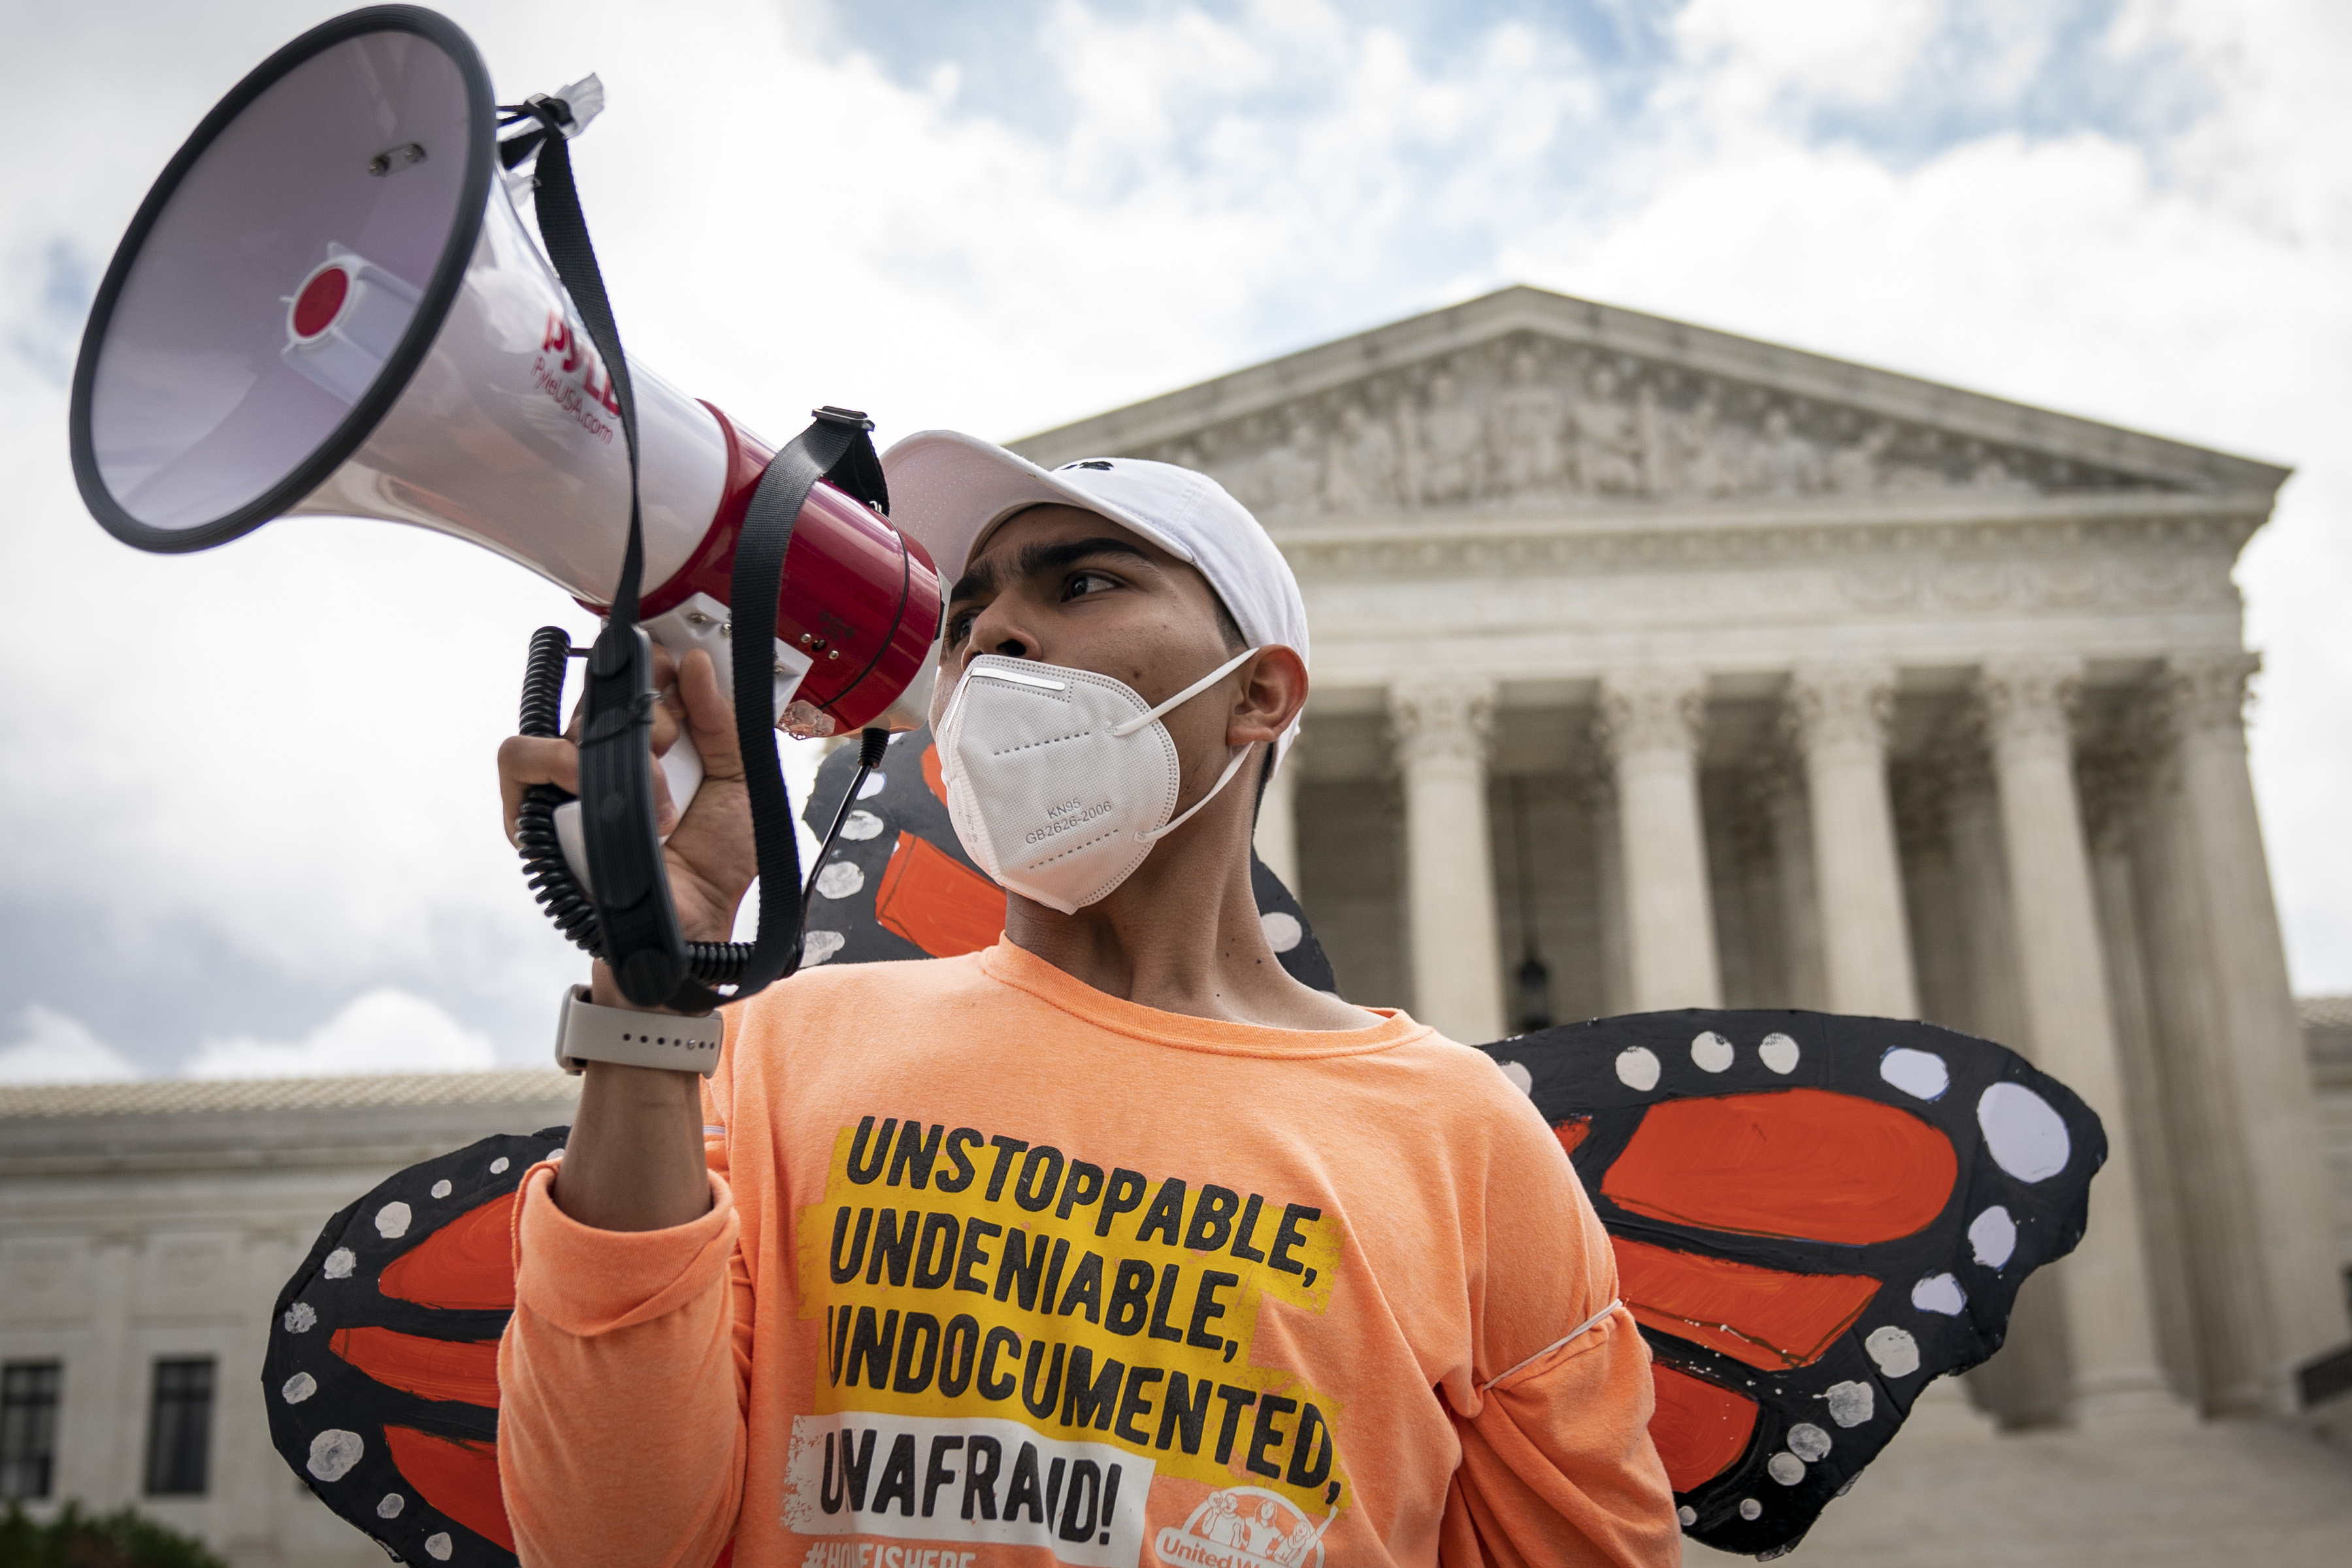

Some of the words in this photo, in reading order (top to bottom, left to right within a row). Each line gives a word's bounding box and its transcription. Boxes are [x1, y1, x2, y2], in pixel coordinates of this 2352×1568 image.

[1025, 801, 1111, 845] GB2626-2006
[1047, 798, 1081, 820] KN95
[846, 1115, 1321, 1287] UNSTOPPABLE,
[830, 1206, 1239, 1364] UNDENIABLE,
[826, 1305, 1341, 1505] UNDOCUMENTED,
[819, 1428, 1122, 1545] UNAFRAID!
[1162, 1535, 1233, 1568] United
